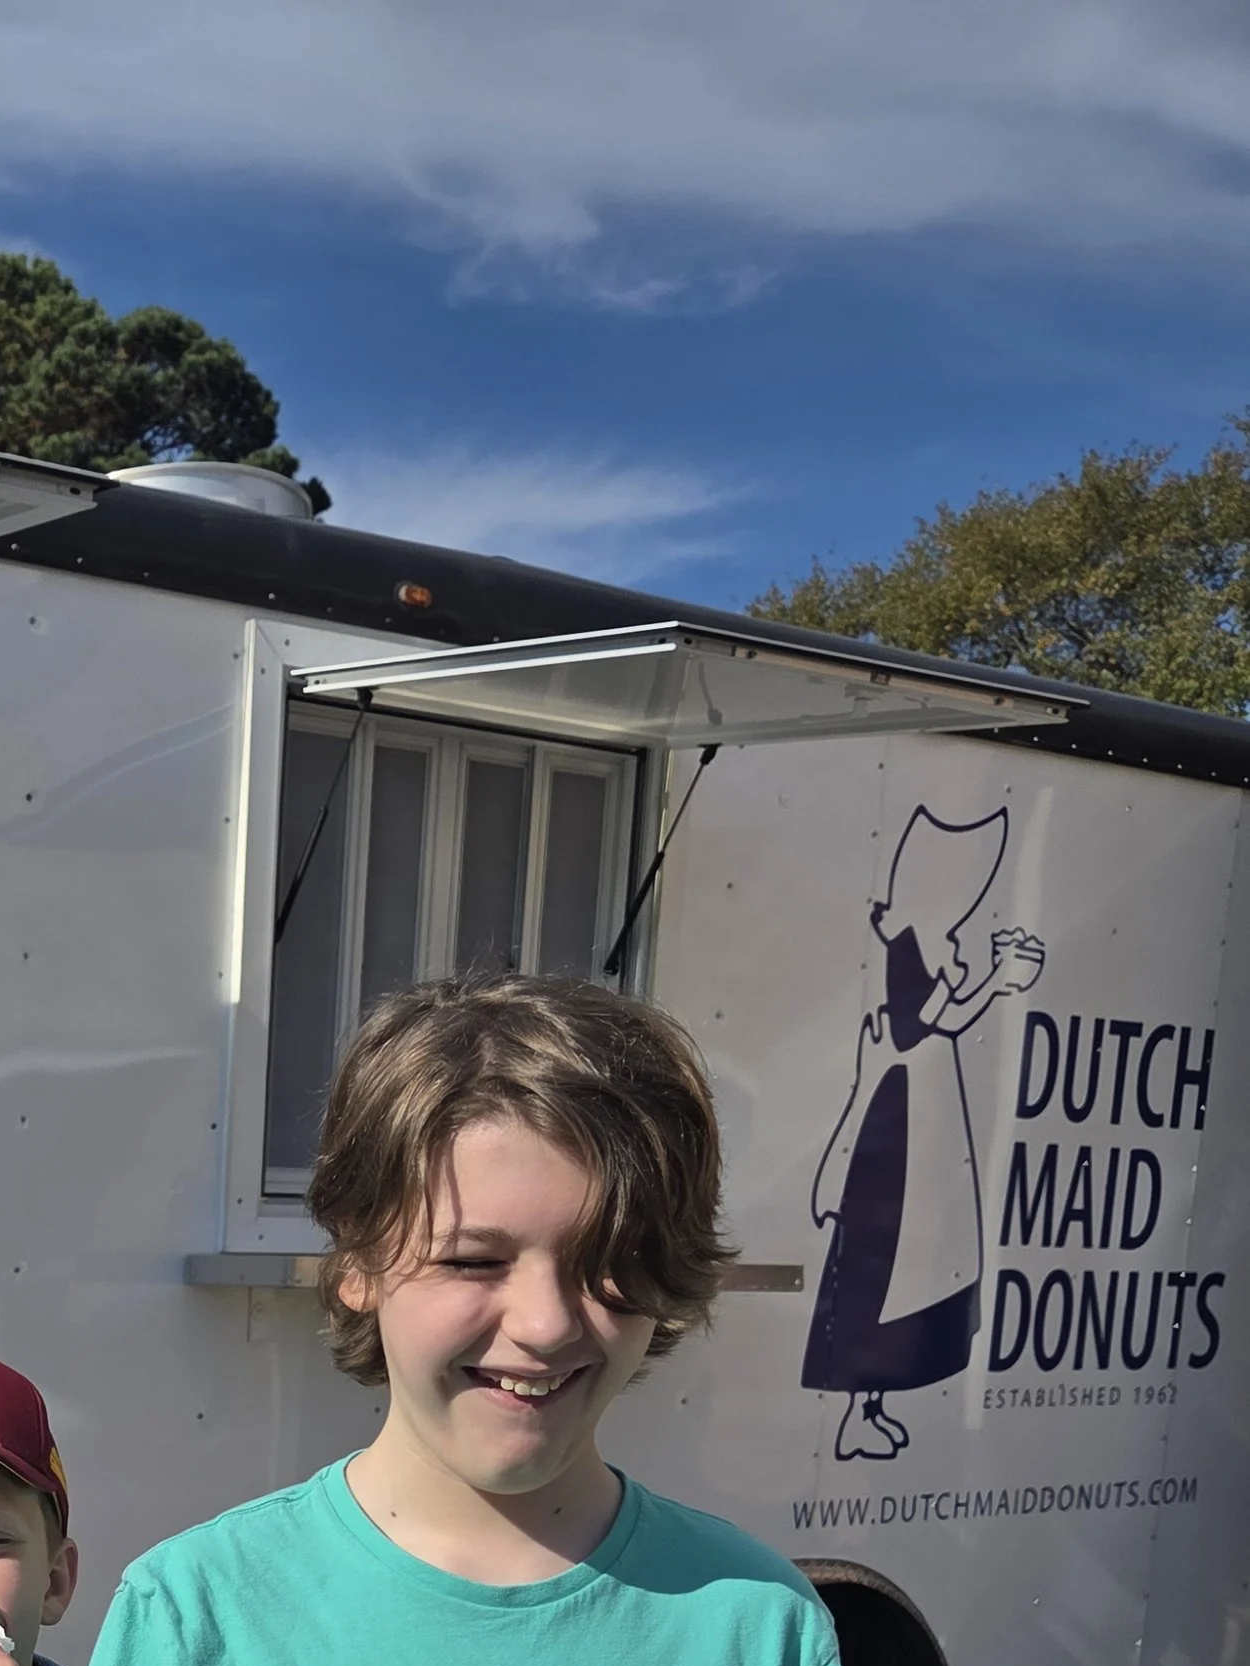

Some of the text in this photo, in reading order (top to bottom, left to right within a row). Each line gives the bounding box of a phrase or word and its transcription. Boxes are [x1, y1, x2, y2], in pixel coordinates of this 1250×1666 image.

[1016, 1011, 1215, 1130] DUTCH
[999, 1142, 1162, 1250] MAID
[988, 1270, 1225, 1373] DONUTS
[983, 1384, 1121, 1410] ESTABLISHED
[793, 1477, 1198, 1529] WWW.DUTCHMAIDDONUTS.COM
